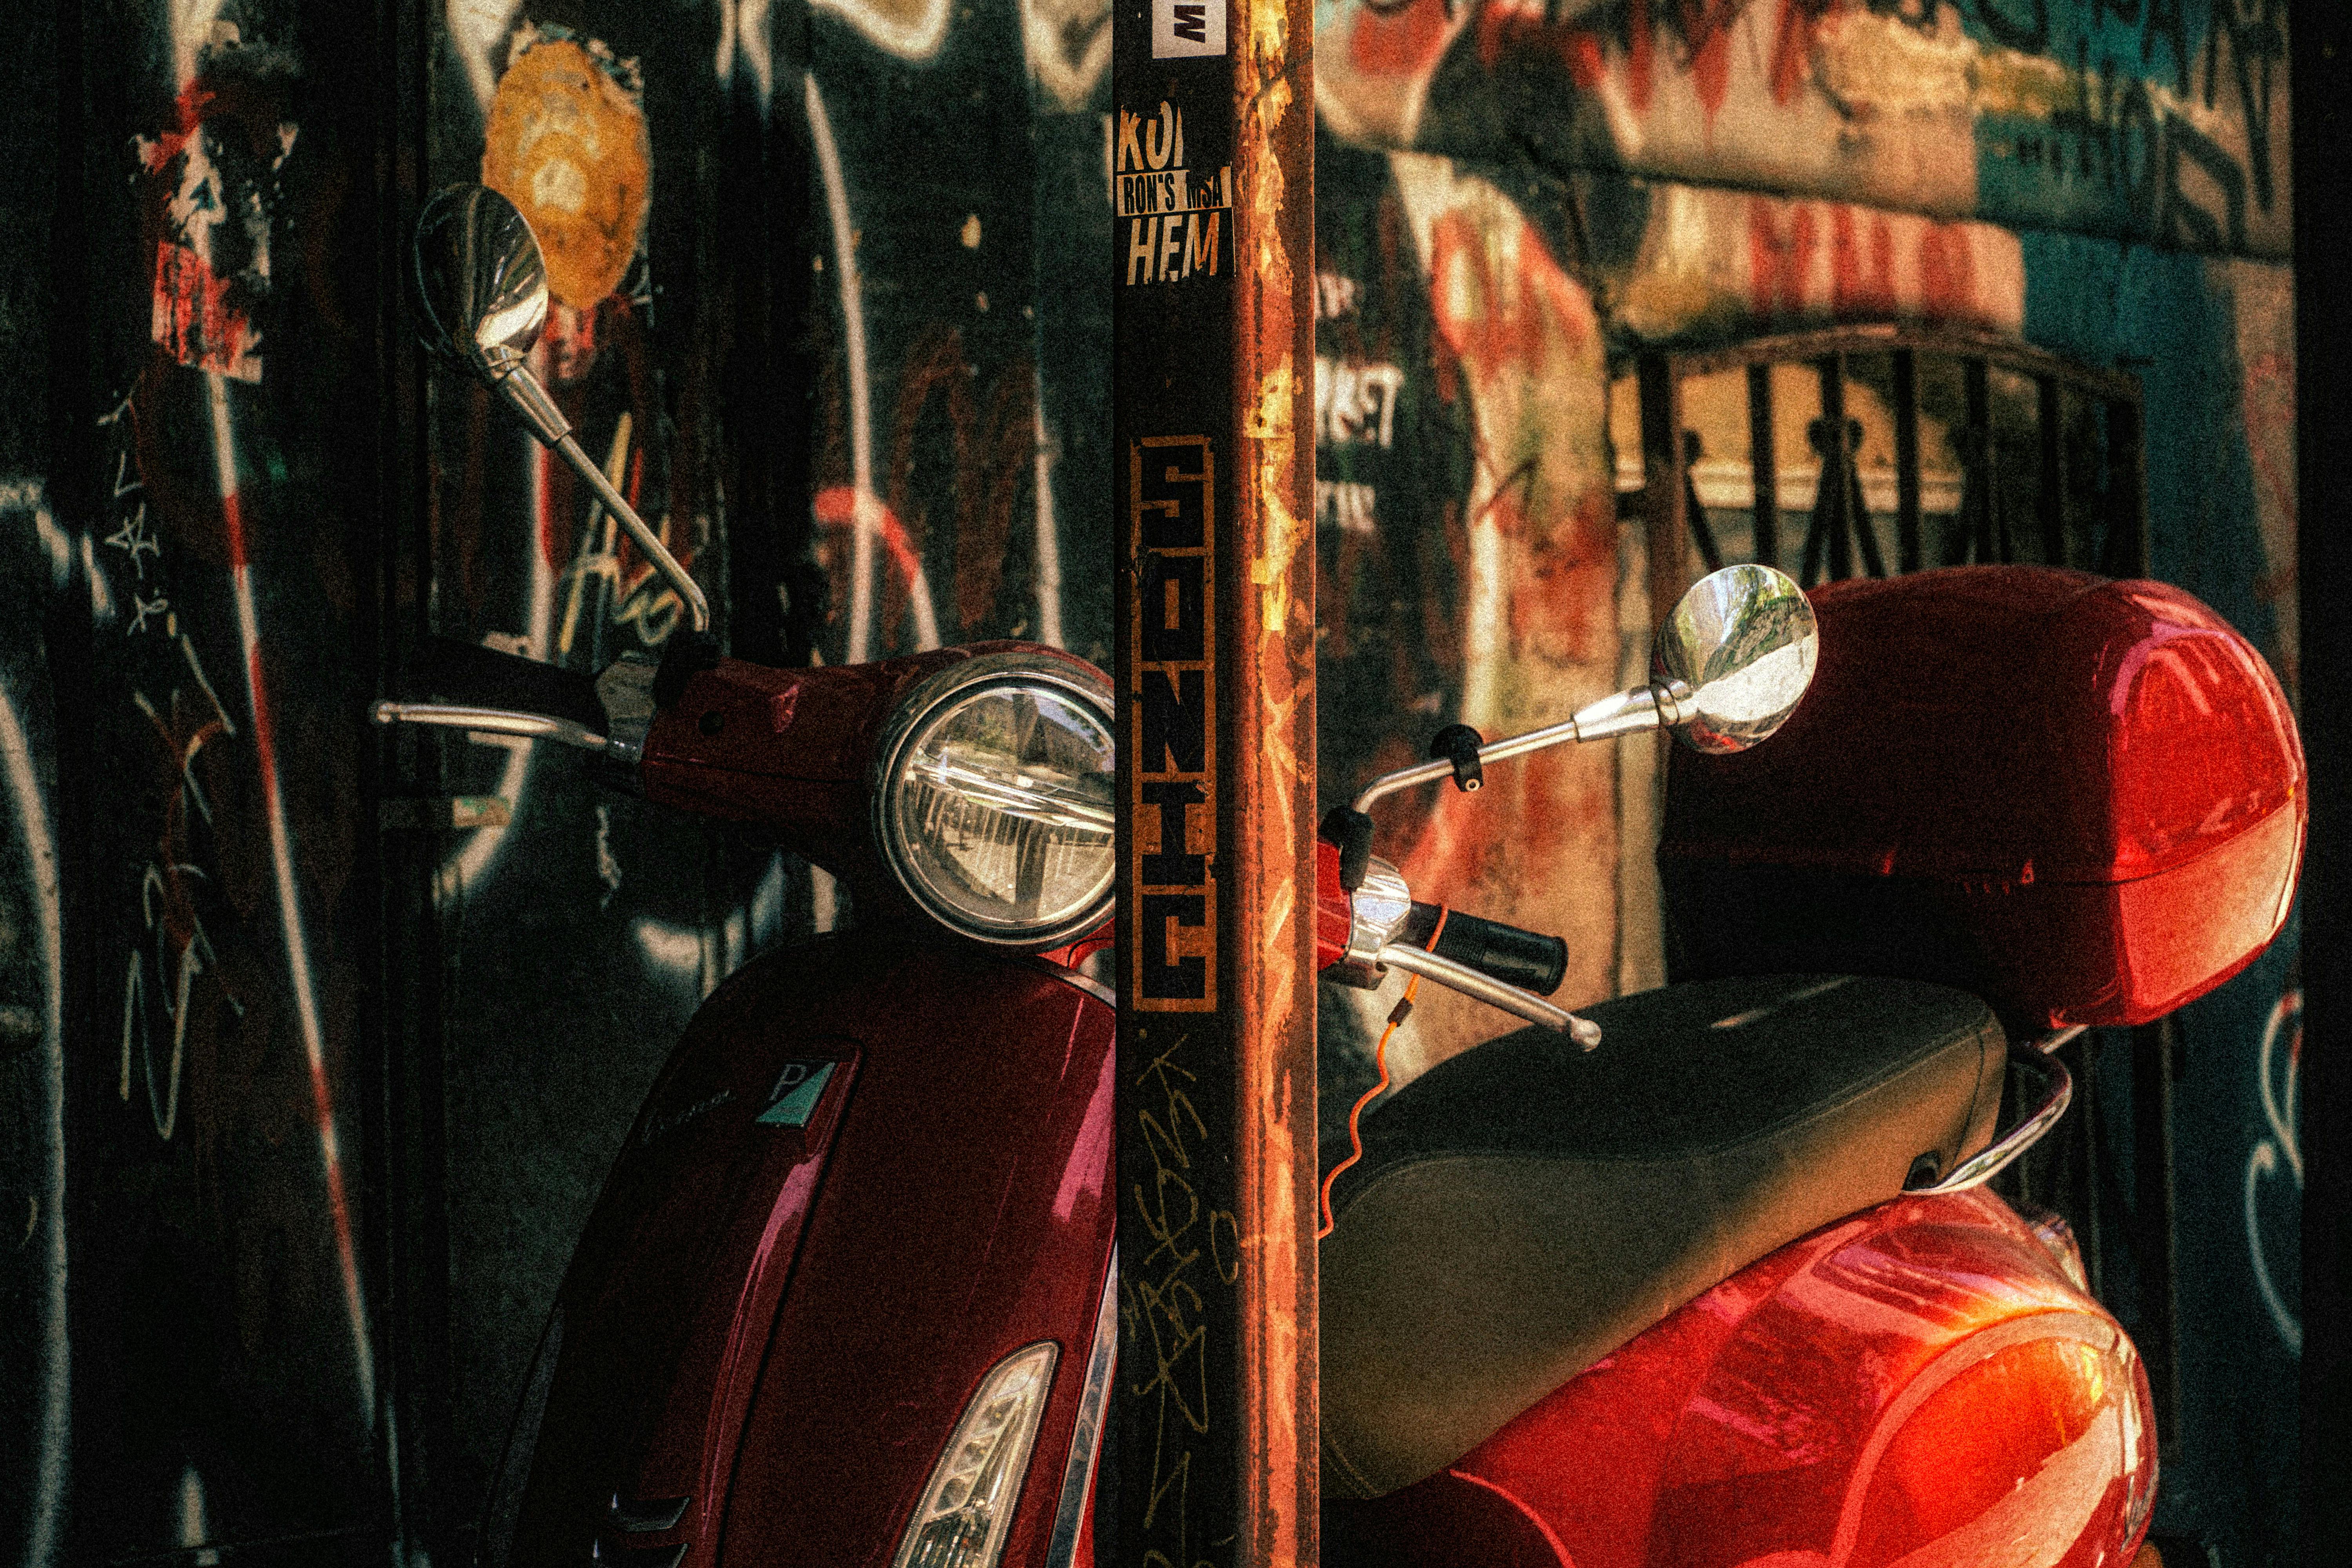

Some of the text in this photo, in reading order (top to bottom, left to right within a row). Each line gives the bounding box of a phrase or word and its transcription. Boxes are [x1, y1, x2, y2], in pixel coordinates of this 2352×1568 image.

[1123, 172, 1176, 214] RON'S
[1126, 212, 1220, 286] HEM
[1140, 444, 1206, 999] SONIC
[768, 1063, 808, 1101] P
